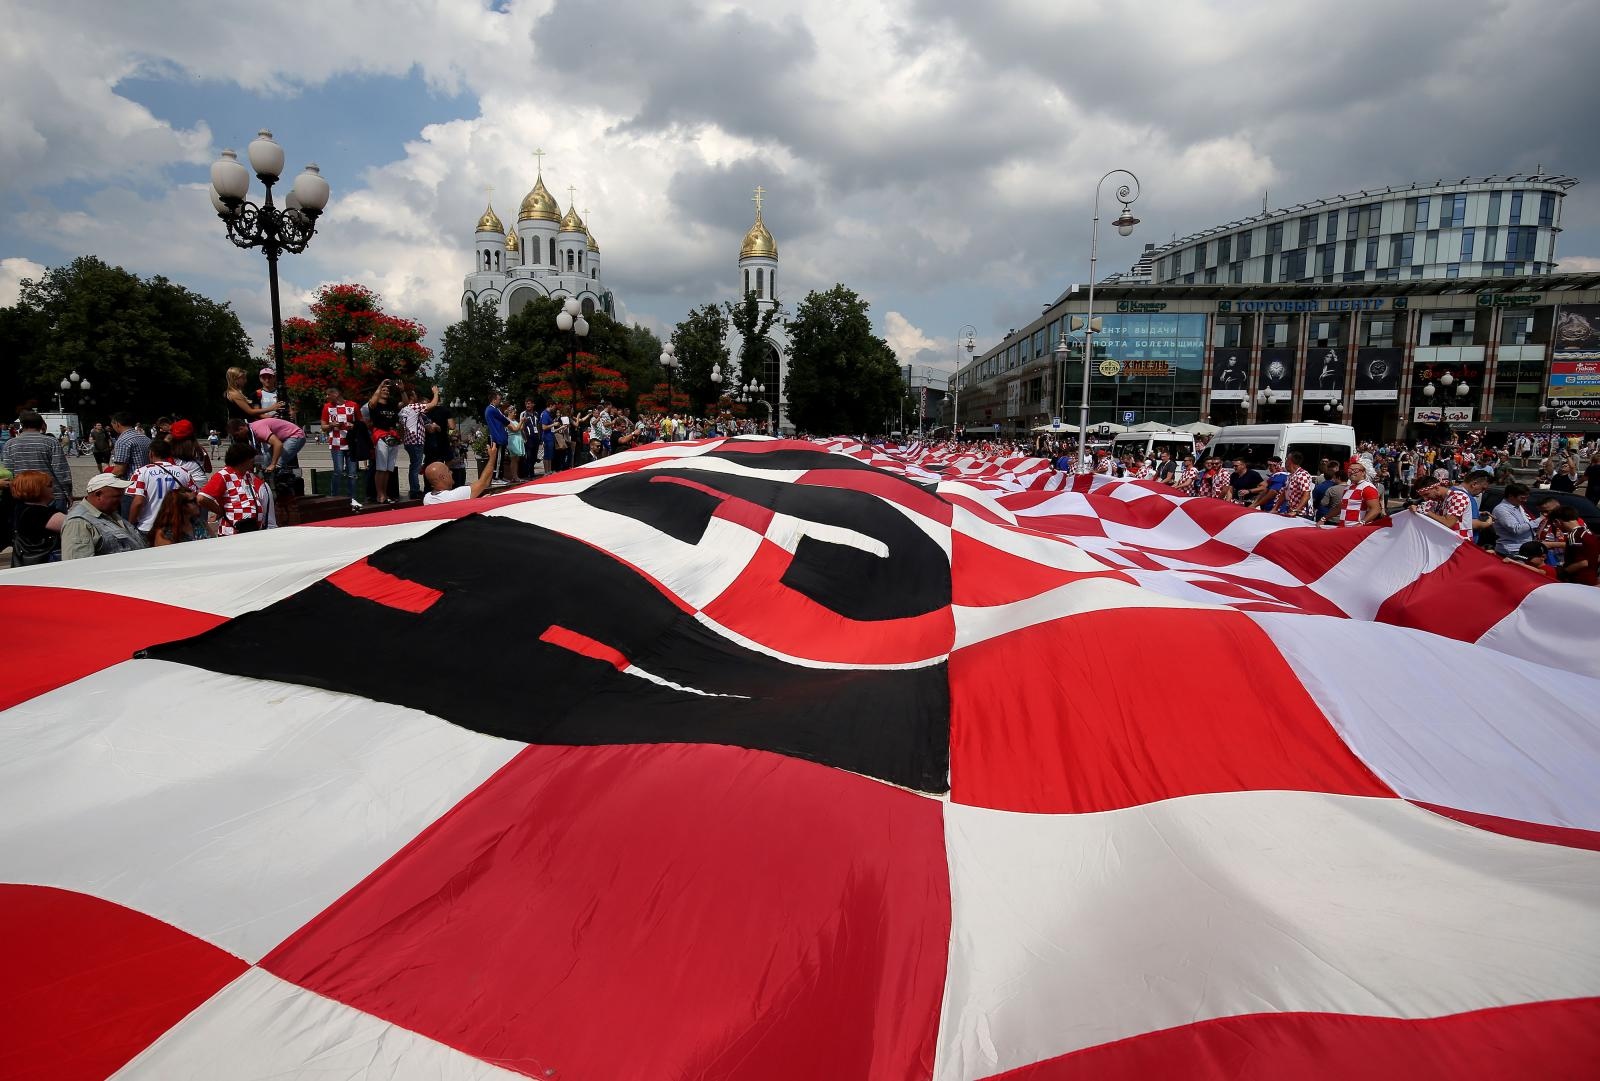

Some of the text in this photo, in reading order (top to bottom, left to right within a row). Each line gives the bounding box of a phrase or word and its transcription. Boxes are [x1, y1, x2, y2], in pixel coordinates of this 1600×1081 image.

[1236, 299, 1384, 312] ТОРГОВЫЙ ЦЕНТР
[1072, 340, 1204, 348] ПАПОРТА БОЛЕЛЬЩИКА
[1123, 360, 1168, 369] ХМЕЛЬ
[1449, 411, 1468, 420] Сало
